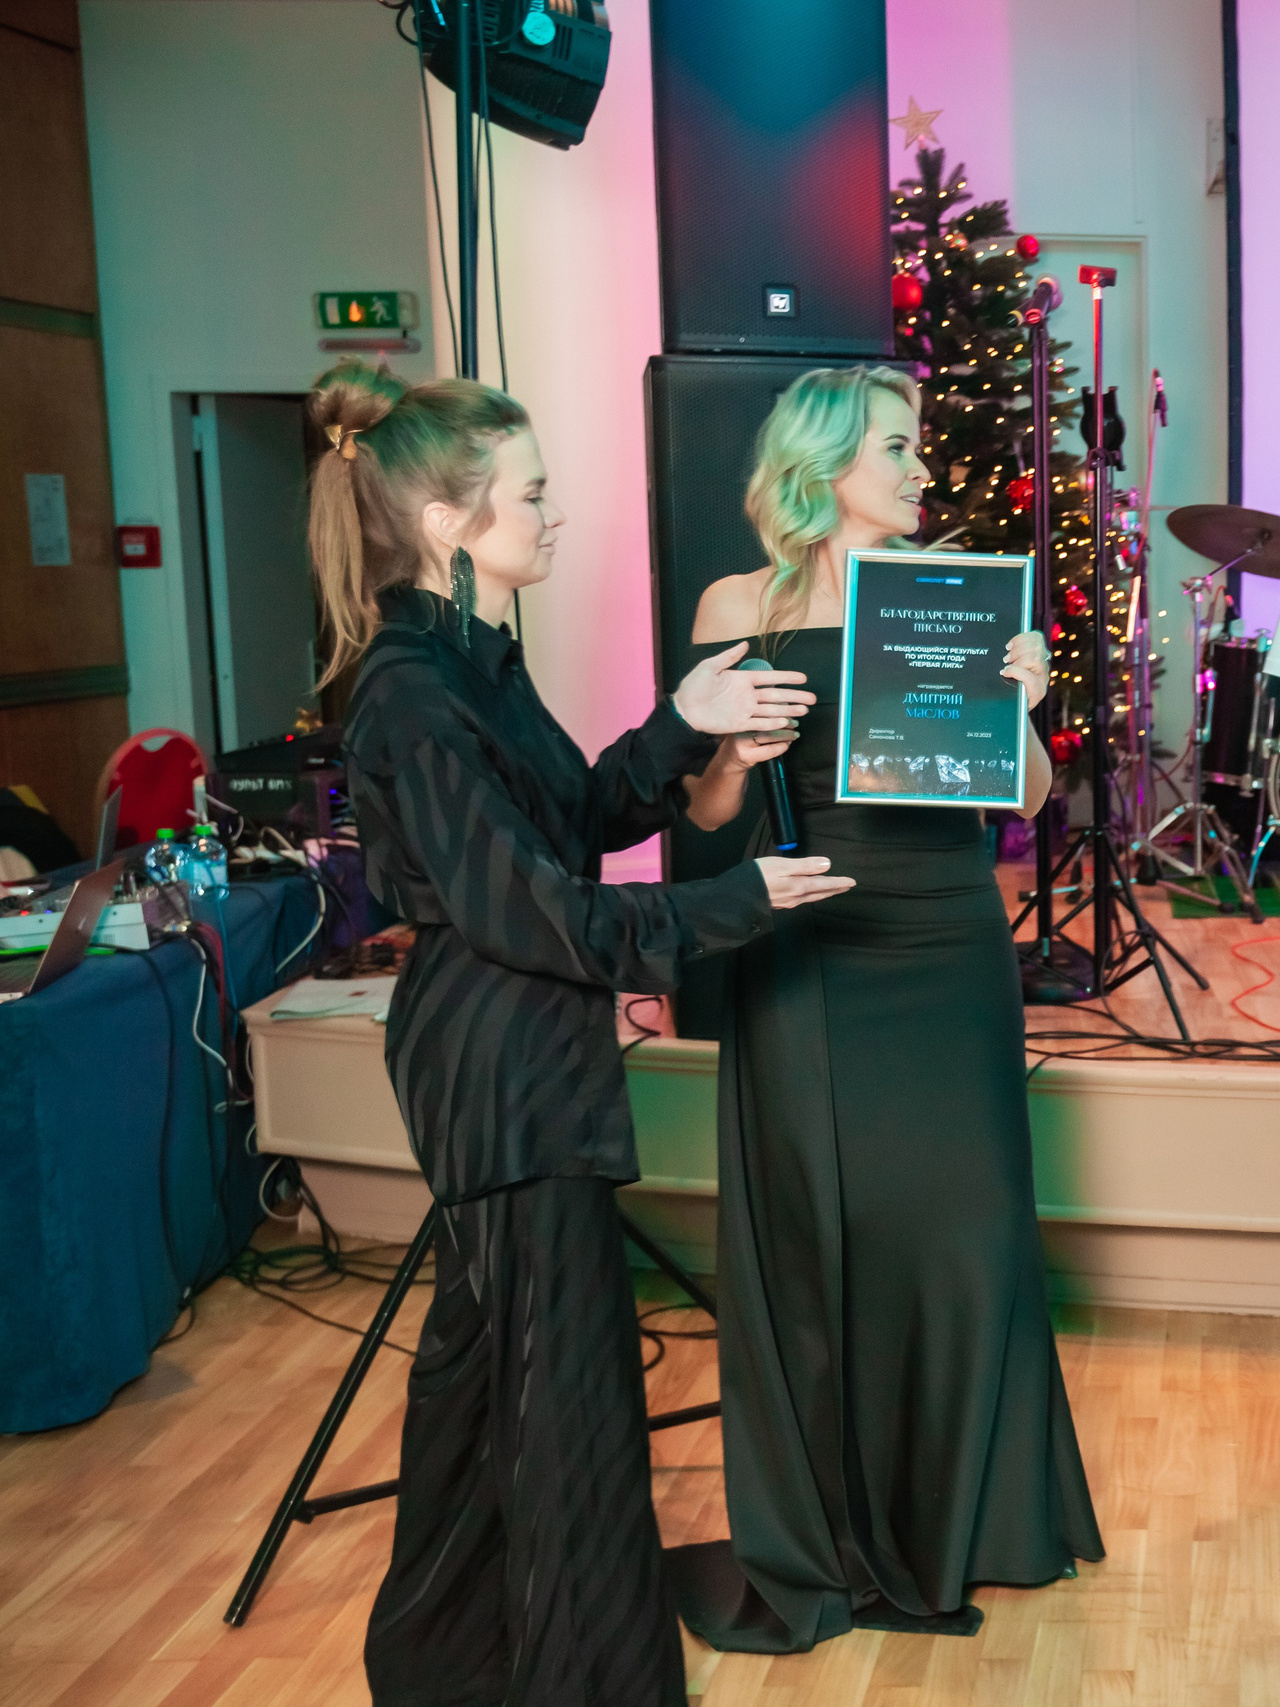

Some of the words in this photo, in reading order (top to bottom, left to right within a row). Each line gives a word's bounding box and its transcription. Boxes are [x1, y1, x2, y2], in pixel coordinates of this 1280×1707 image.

[880, 608, 996, 622] БЛАГОДАРСТВЕННОЕ
[913, 623, 963, 634] ПИСЬМО
[894, 645, 948, 654] ВЫДАЮЩИЙСЯ
[949, 647, 989, 656] РЕЗУЛЬТАТ
[917, 653, 946, 661] ИТОГАМ
[902, 692, 964, 705] ДМИТРИЙ
